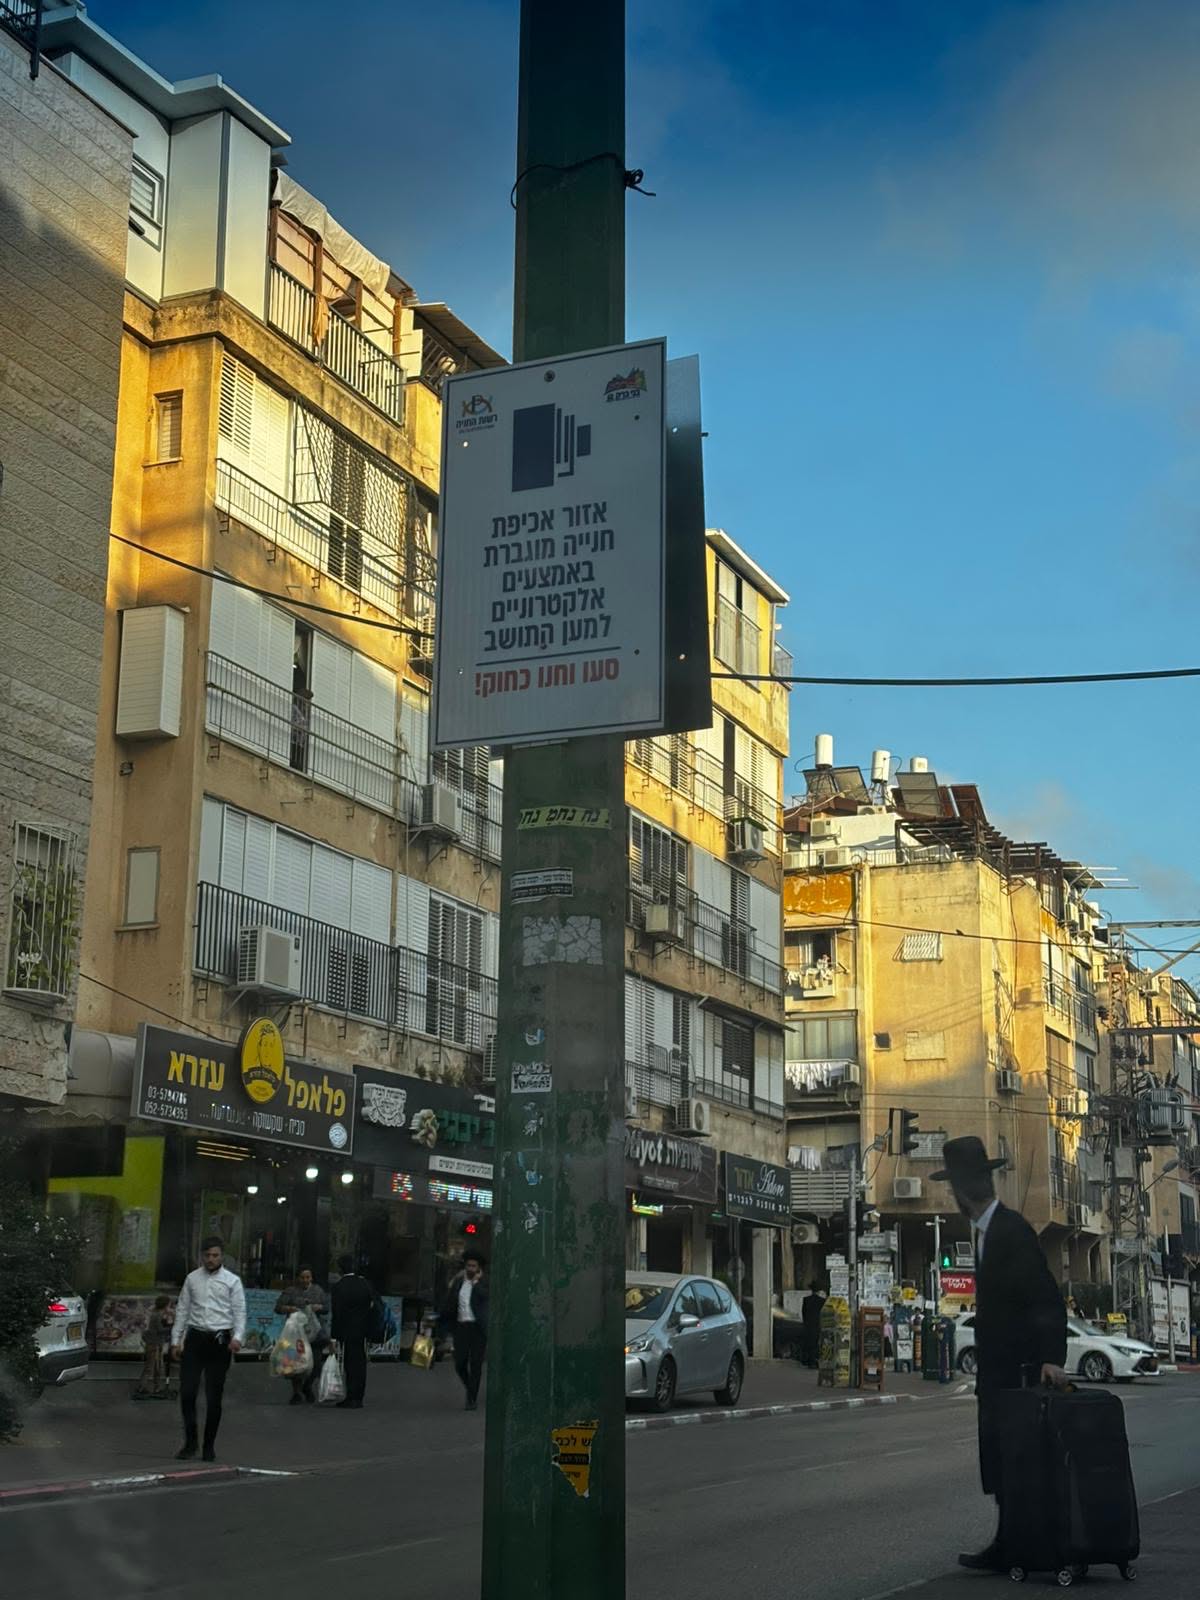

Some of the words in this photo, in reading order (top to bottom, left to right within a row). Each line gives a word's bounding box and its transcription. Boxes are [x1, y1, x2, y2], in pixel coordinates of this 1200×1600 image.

[491, 508, 555, 539] אכיפת
[562, 501, 607, 528] אזור
[483, 537, 556, 568] מוגברת
[563, 529, 615, 557] חנייה
[502, 560, 595, 593] באמצעים
[491, 586, 605, 623] אלקטרוניים
[483, 622, 554, 652] התושב
[562, 613, 612, 647] למען
[474, 668, 531, 698] כחוק!
[537, 662, 576, 689] וחנו
[582, 657, 620, 684] סעו
[167, 1049, 226, 1092] עזרא
[284, 1066, 347, 1117] פלאפל
